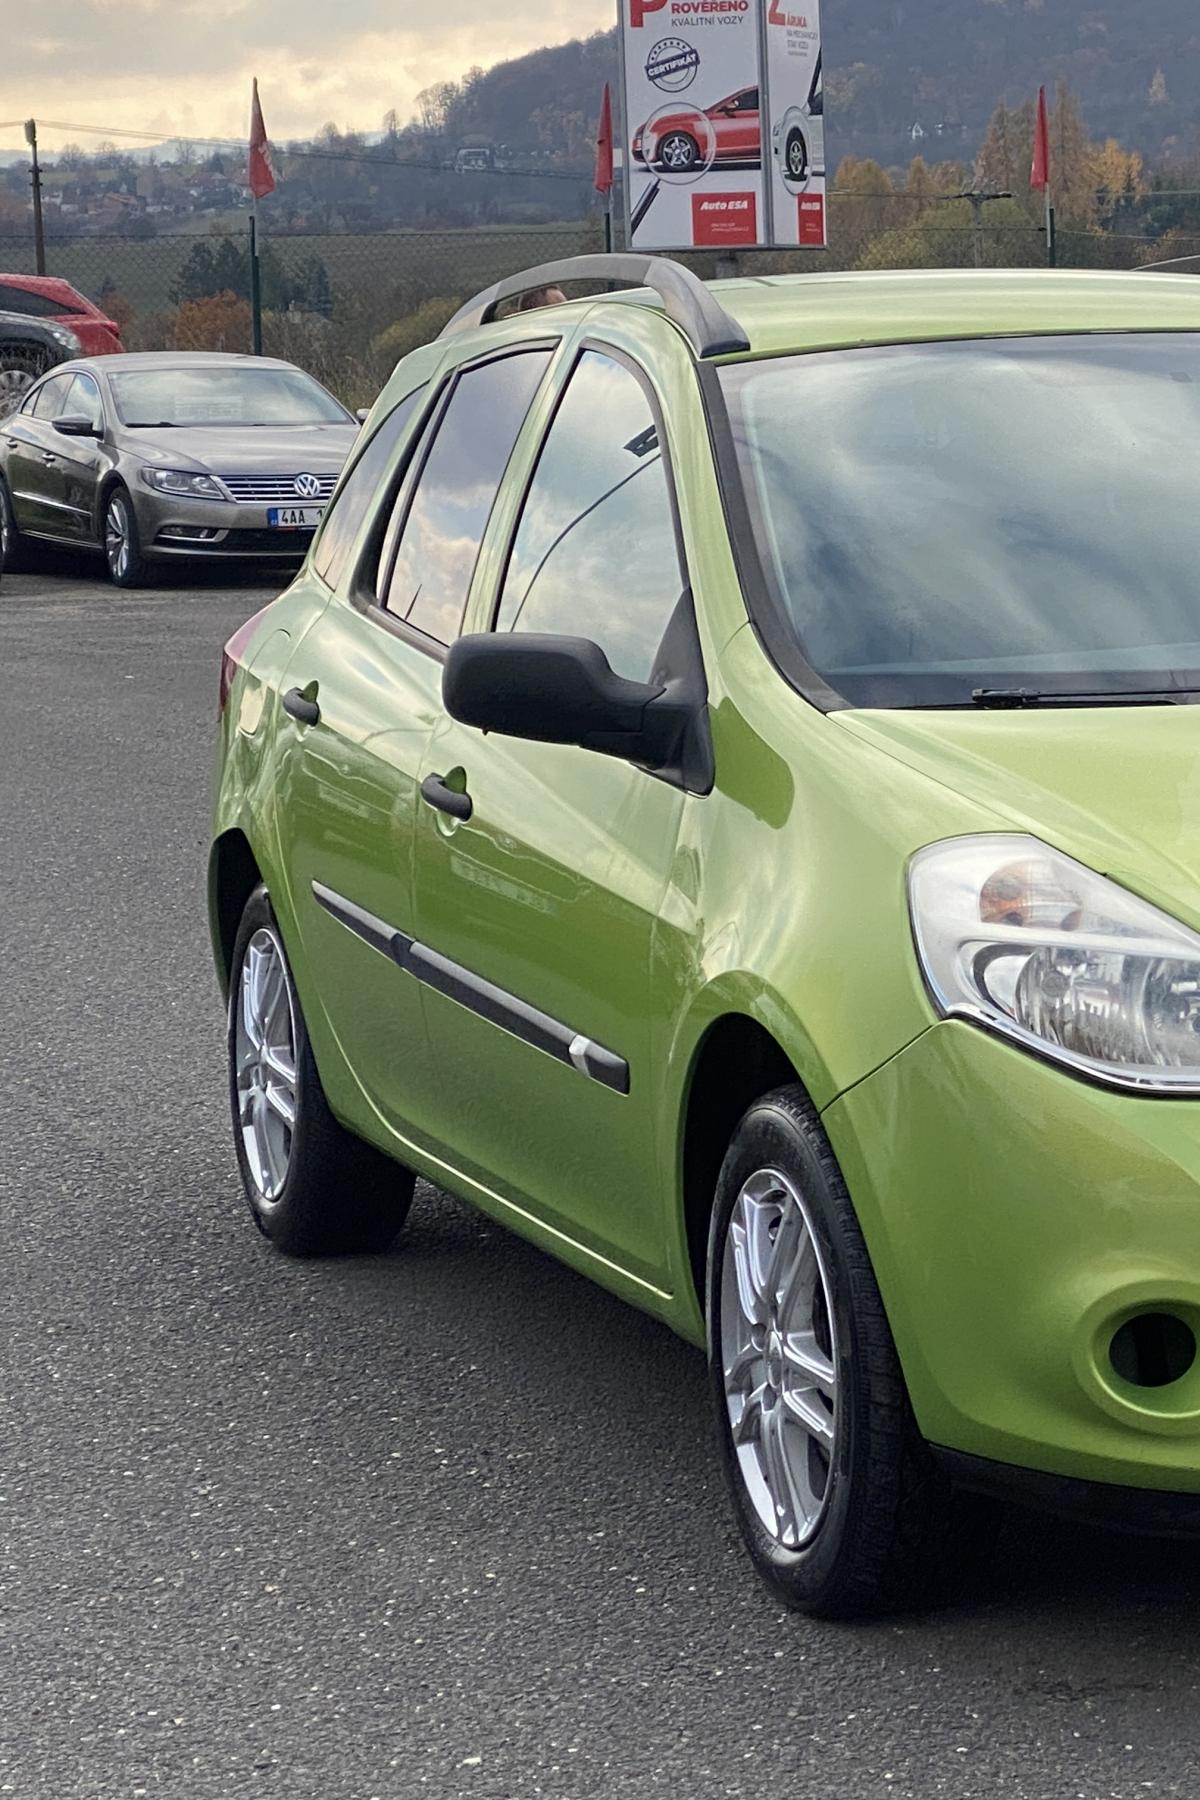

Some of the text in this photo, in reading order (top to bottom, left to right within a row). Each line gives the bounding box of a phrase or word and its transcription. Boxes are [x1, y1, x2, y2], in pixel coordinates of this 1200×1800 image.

[671, 15, 744, 27] KVALITNÍ VOZY
[700, 200, 748, 210] Auto ESA
[281, 510, 305, 524] 4AA
